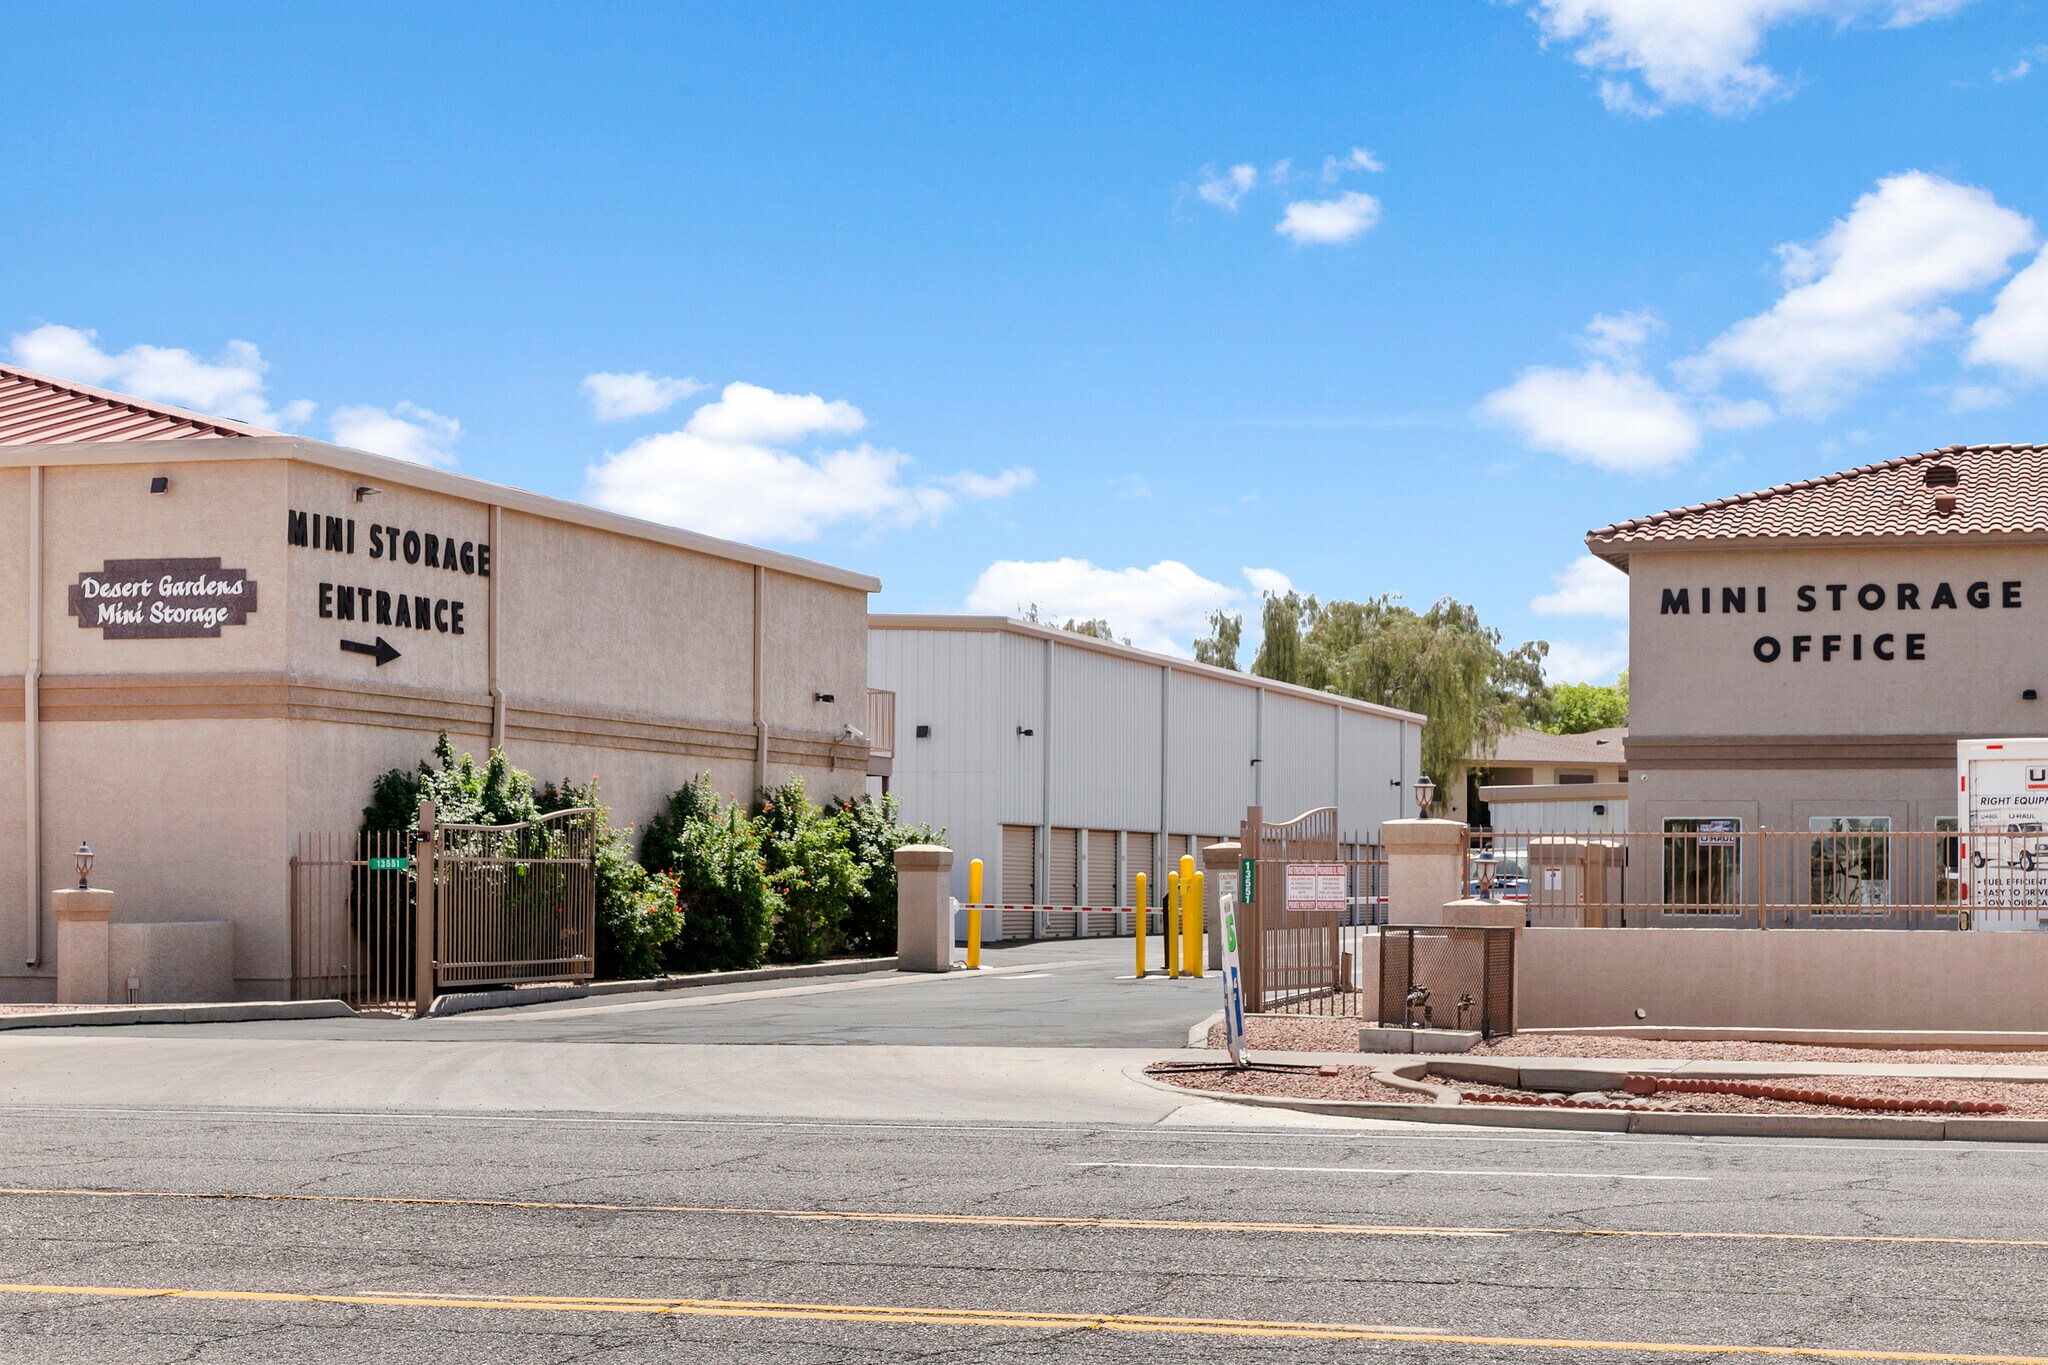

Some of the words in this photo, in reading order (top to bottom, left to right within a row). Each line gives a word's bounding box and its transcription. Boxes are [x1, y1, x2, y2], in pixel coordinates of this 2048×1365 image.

[287, 509, 355, 554] MINI
[369, 523, 491, 577] STORAGE
[81, 576, 153, 599] Desert
[158, 574, 243, 598] Gardens
[1660, 586, 1767, 615] MINI
[1796, 581, 2022, 613] STORAGE
[97, 601, 145, 626] Mini
[149, 600, 229, 629] Storage
[318, 582, 465, 635] ENTRANCE
[1753, 633, 1926, 664] OFFICE
[1981, 797, 2011, 805] RIGHT
[376, 859, 400, 868] 13551
